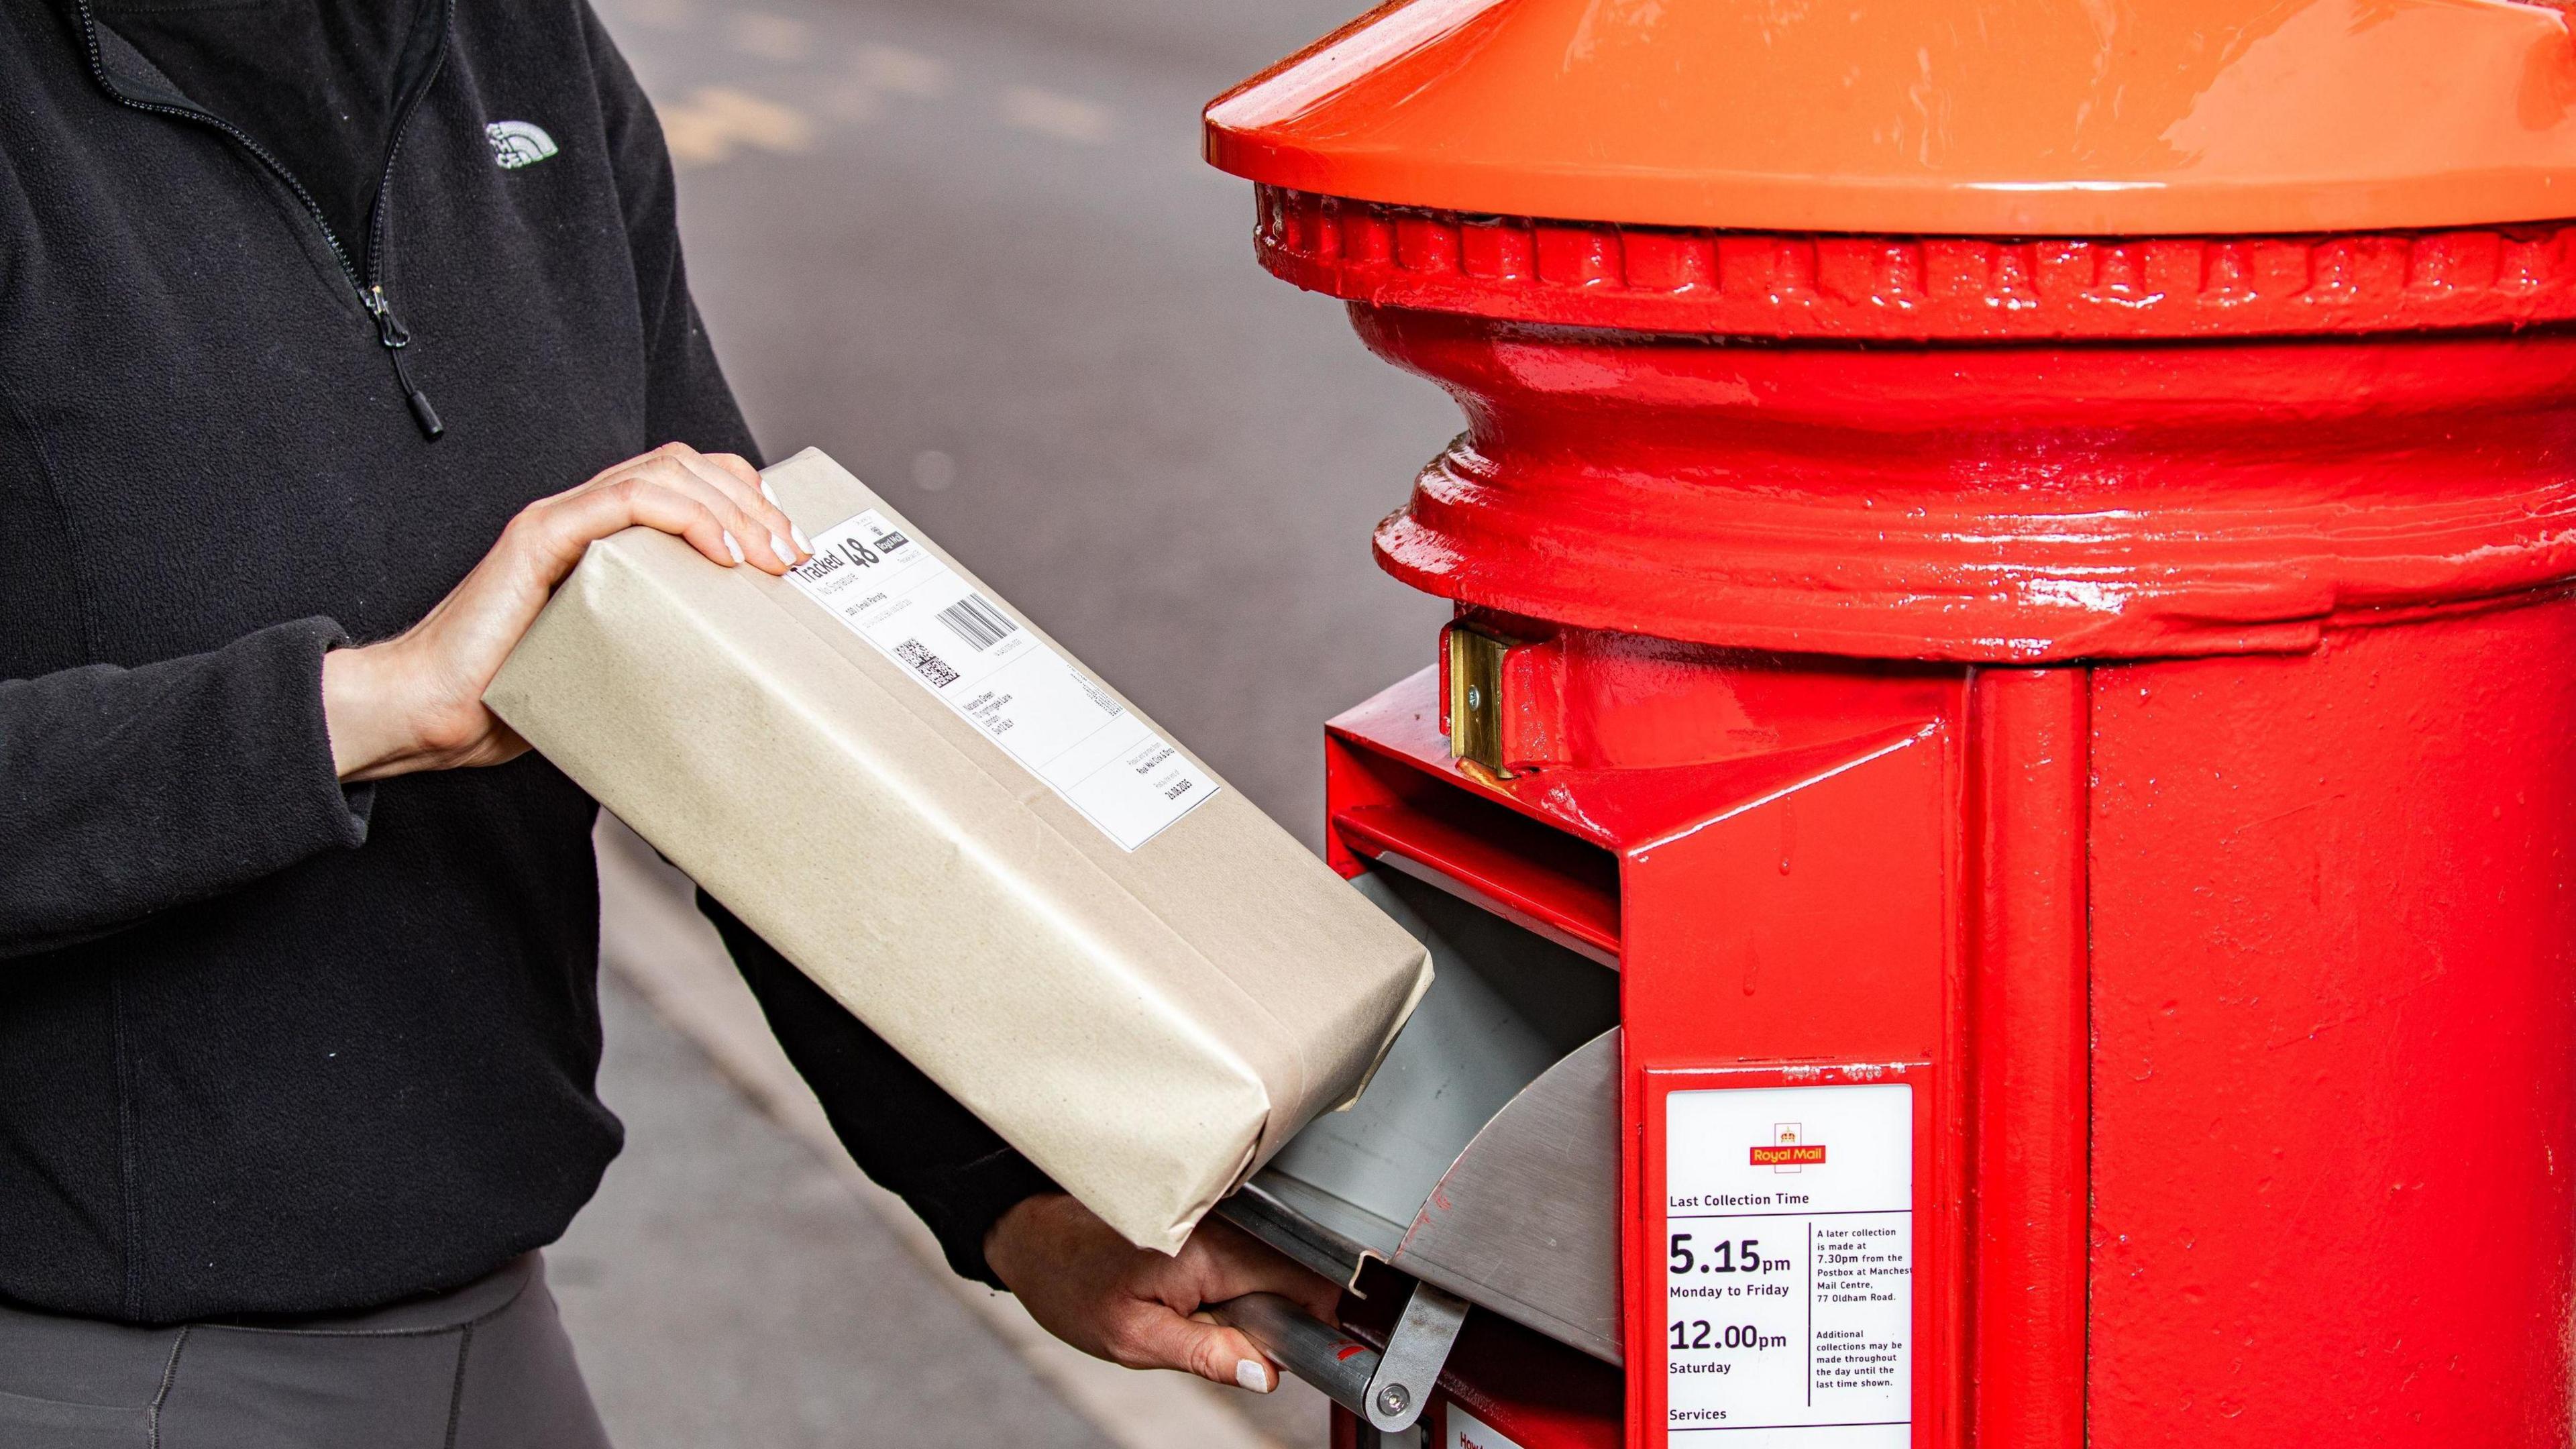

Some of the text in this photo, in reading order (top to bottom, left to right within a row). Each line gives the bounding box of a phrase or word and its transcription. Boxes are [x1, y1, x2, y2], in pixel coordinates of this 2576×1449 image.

[875, 533, 905, 551] Royal Mail
[790, 549, 845, 583] Tracked
[837, 538, 879, 568] 48
[826, 573, 859, 592] Signature
[1165, 779, 1192, 800] 26.08.2025
[1754, 1148, 1821, 1163] Royal Mail
[1670, 1193, 1809, 1207] Last Collection Time
[1852, 1228, 1896, 1236] collection
[1670, 1234, 1790, 1275] 5.15pm
[1818, 1254, 1858, 1265] 7.30pm
[1818, 1269, 1853, 1277] Postbox
[1670, 1284, 1788, 1299] Monday to Friday
[1670, 1320, 1786, 1351] 12.00pm
[1817, 1330, 1863, 1338] Additional
[1817, 1343, 1866, 1351] collections
[1845, 1354, 1896, 1363] throughout
[1670, 1362, 1731, 1375] Saturday
[1835, 1368, 1850, 1377] day
[1855, 1366, 1875, 1375] until
[1670, 1409, 1726, 1420] Services
